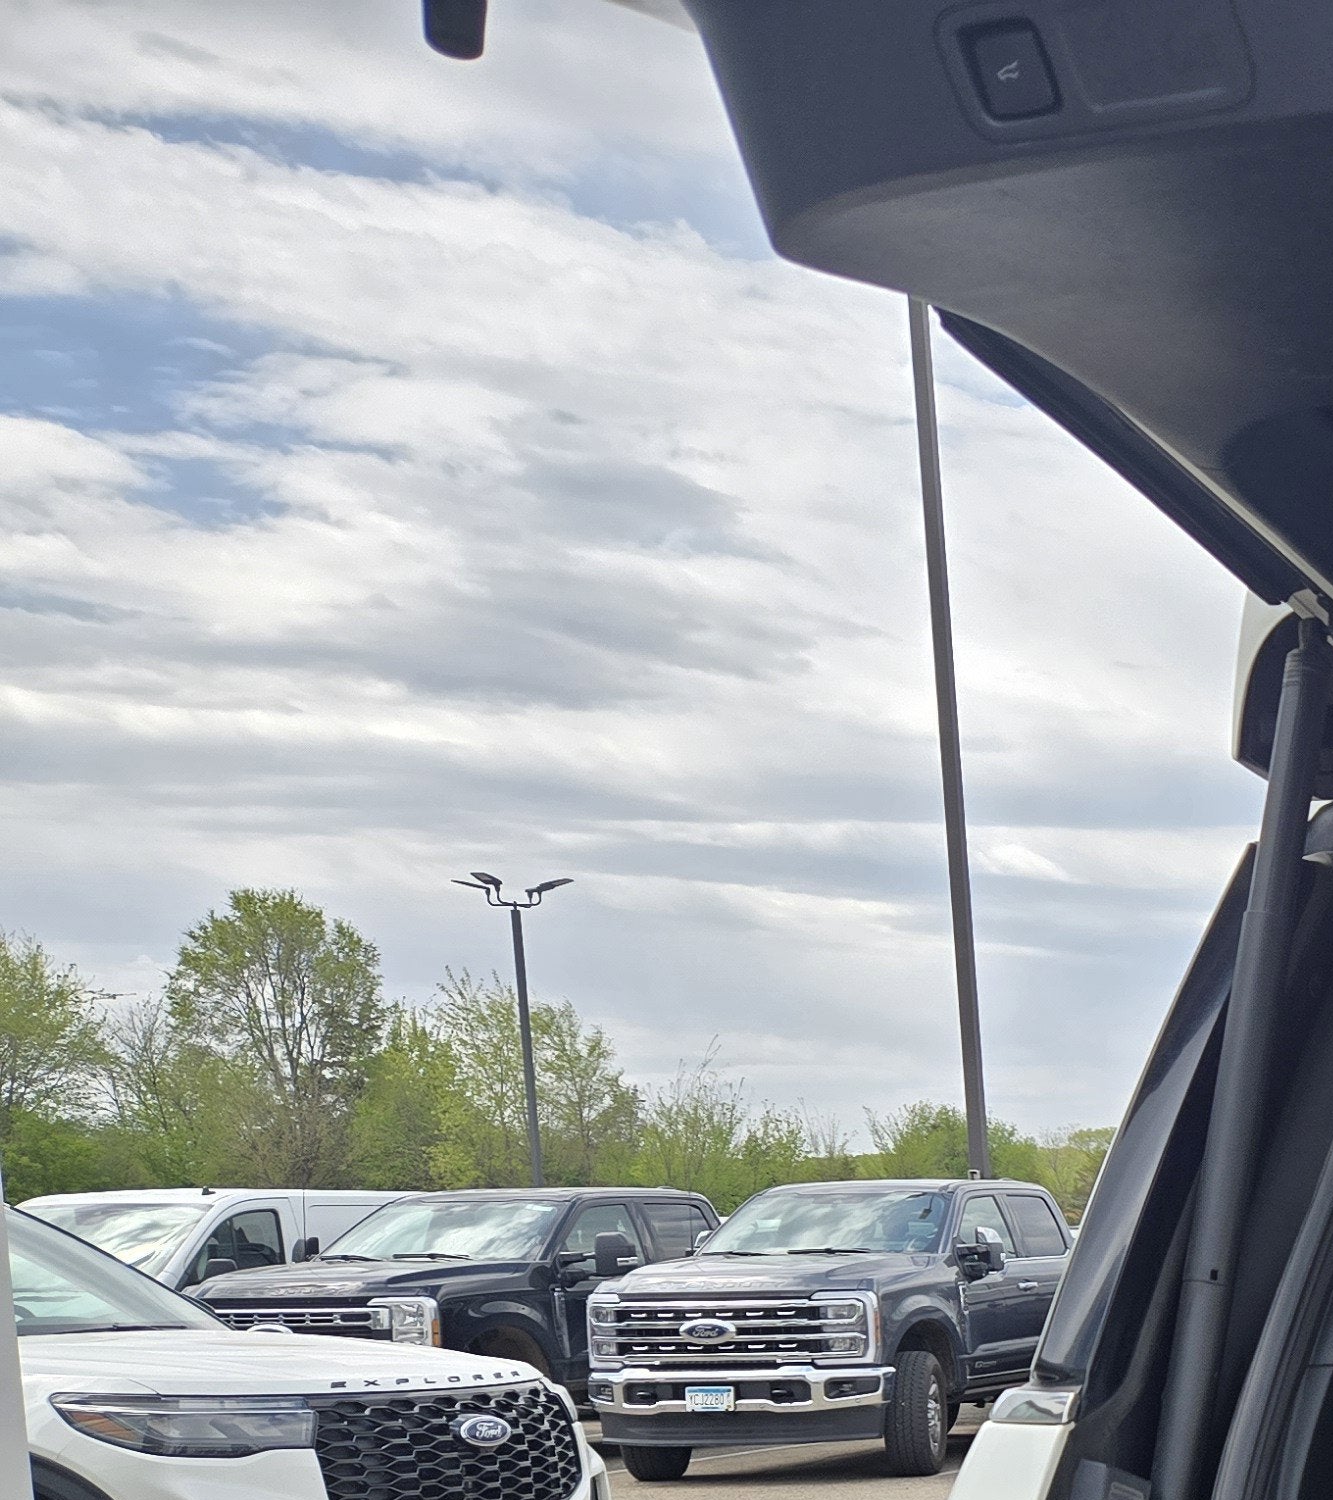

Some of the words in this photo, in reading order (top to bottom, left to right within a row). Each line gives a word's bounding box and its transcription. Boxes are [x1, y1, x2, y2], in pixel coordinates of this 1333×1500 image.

[692, 1324, 719, 1337] Ford
[330, 1370, 521, 1389] EXPLORER
[475, 1421, 503, 1439] Ford
